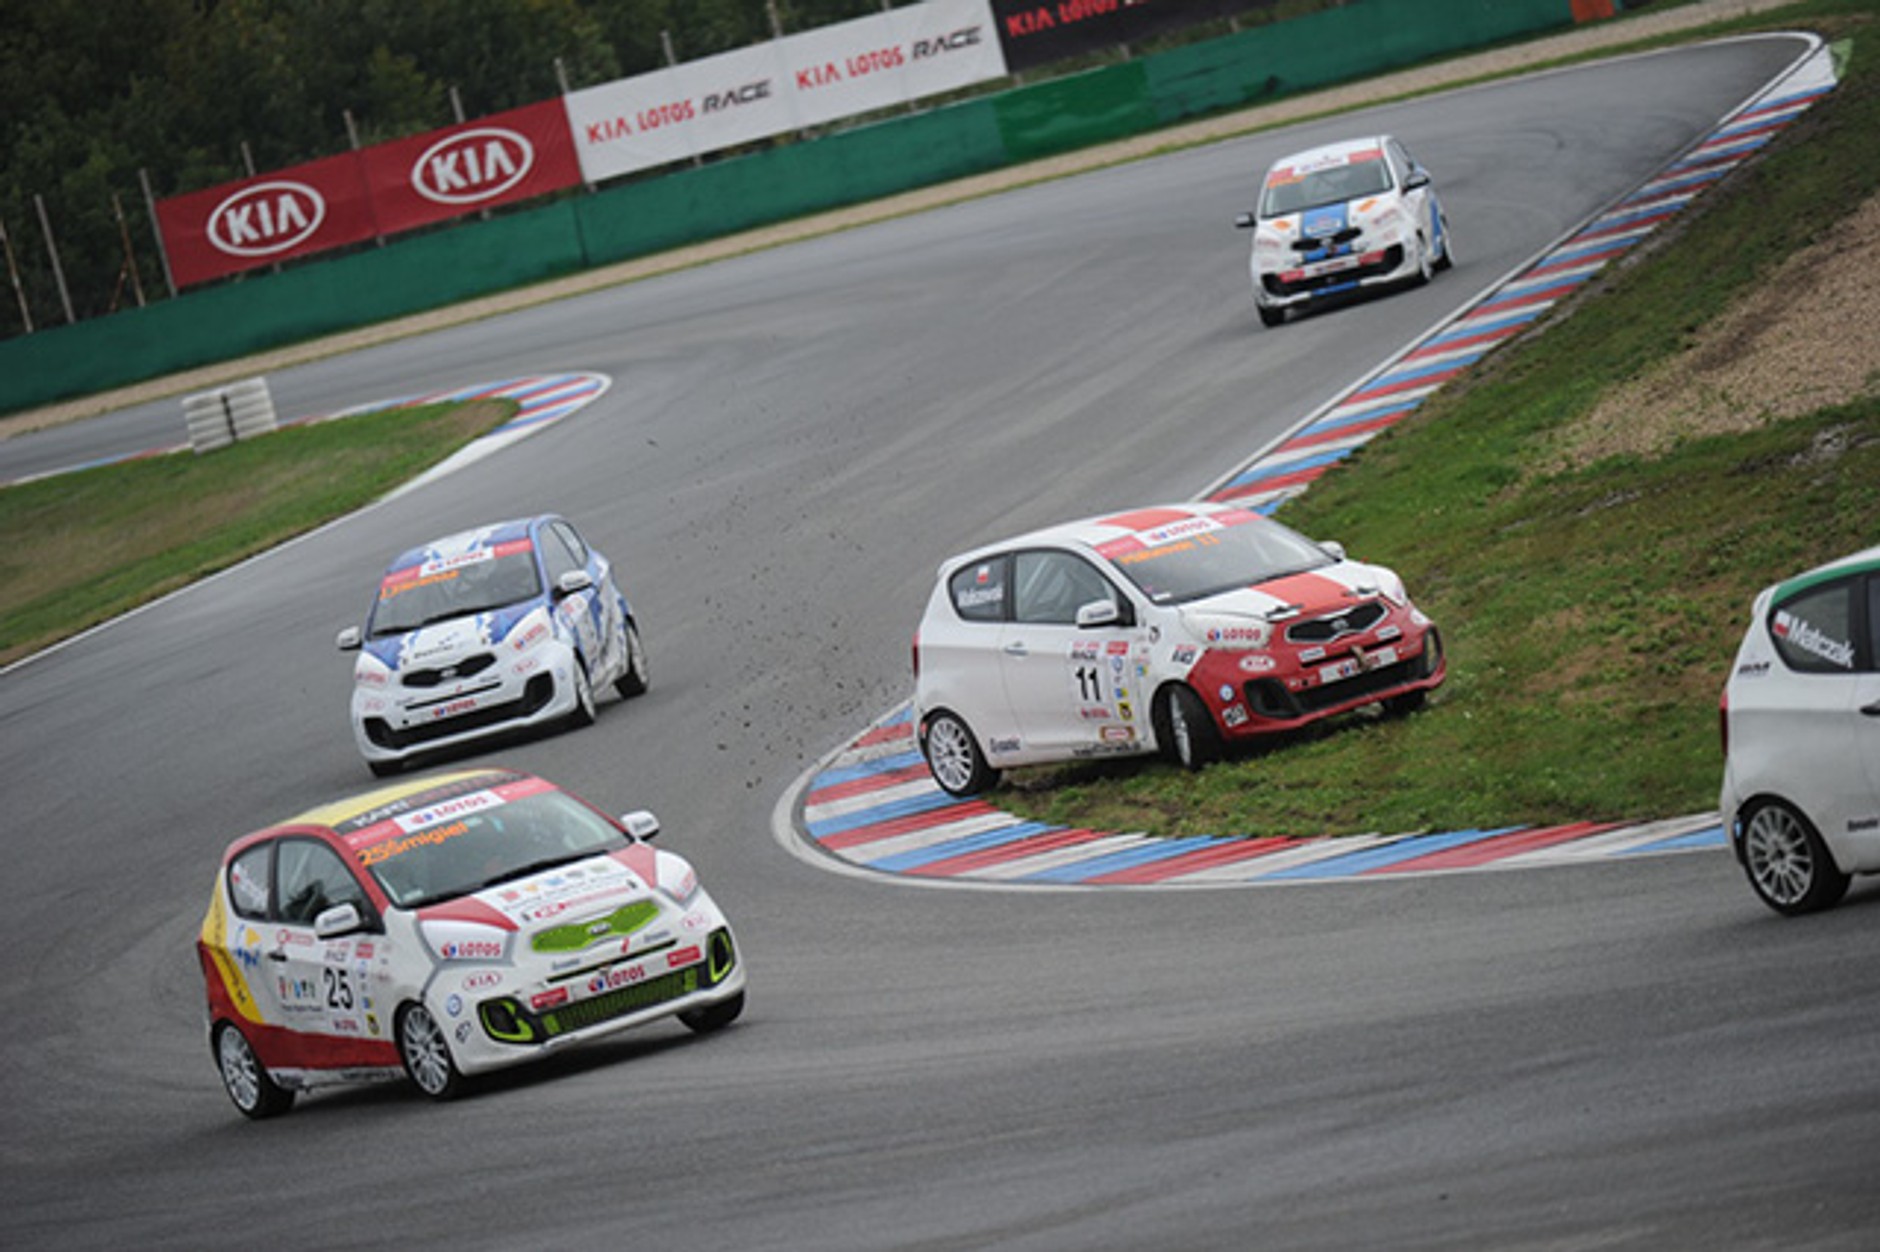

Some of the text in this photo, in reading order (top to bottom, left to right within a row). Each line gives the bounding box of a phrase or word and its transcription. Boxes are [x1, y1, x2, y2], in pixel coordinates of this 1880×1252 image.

[1005, 8, 1055, 37] KIA
[795, 25, 982, 90] KIA LOTOS RACE
[586, 80, 771, 145] KIA LOTOS RACE
[430, 140, 518, 193] KIA
[225, 194, 309, 245] KIA
[1075, 666, 1102, 702] 11
[458, 942, 501, 957] LOTOS
[323, 967, 354, 1010] 25
[604, 965, 646, 989] LOTOS
